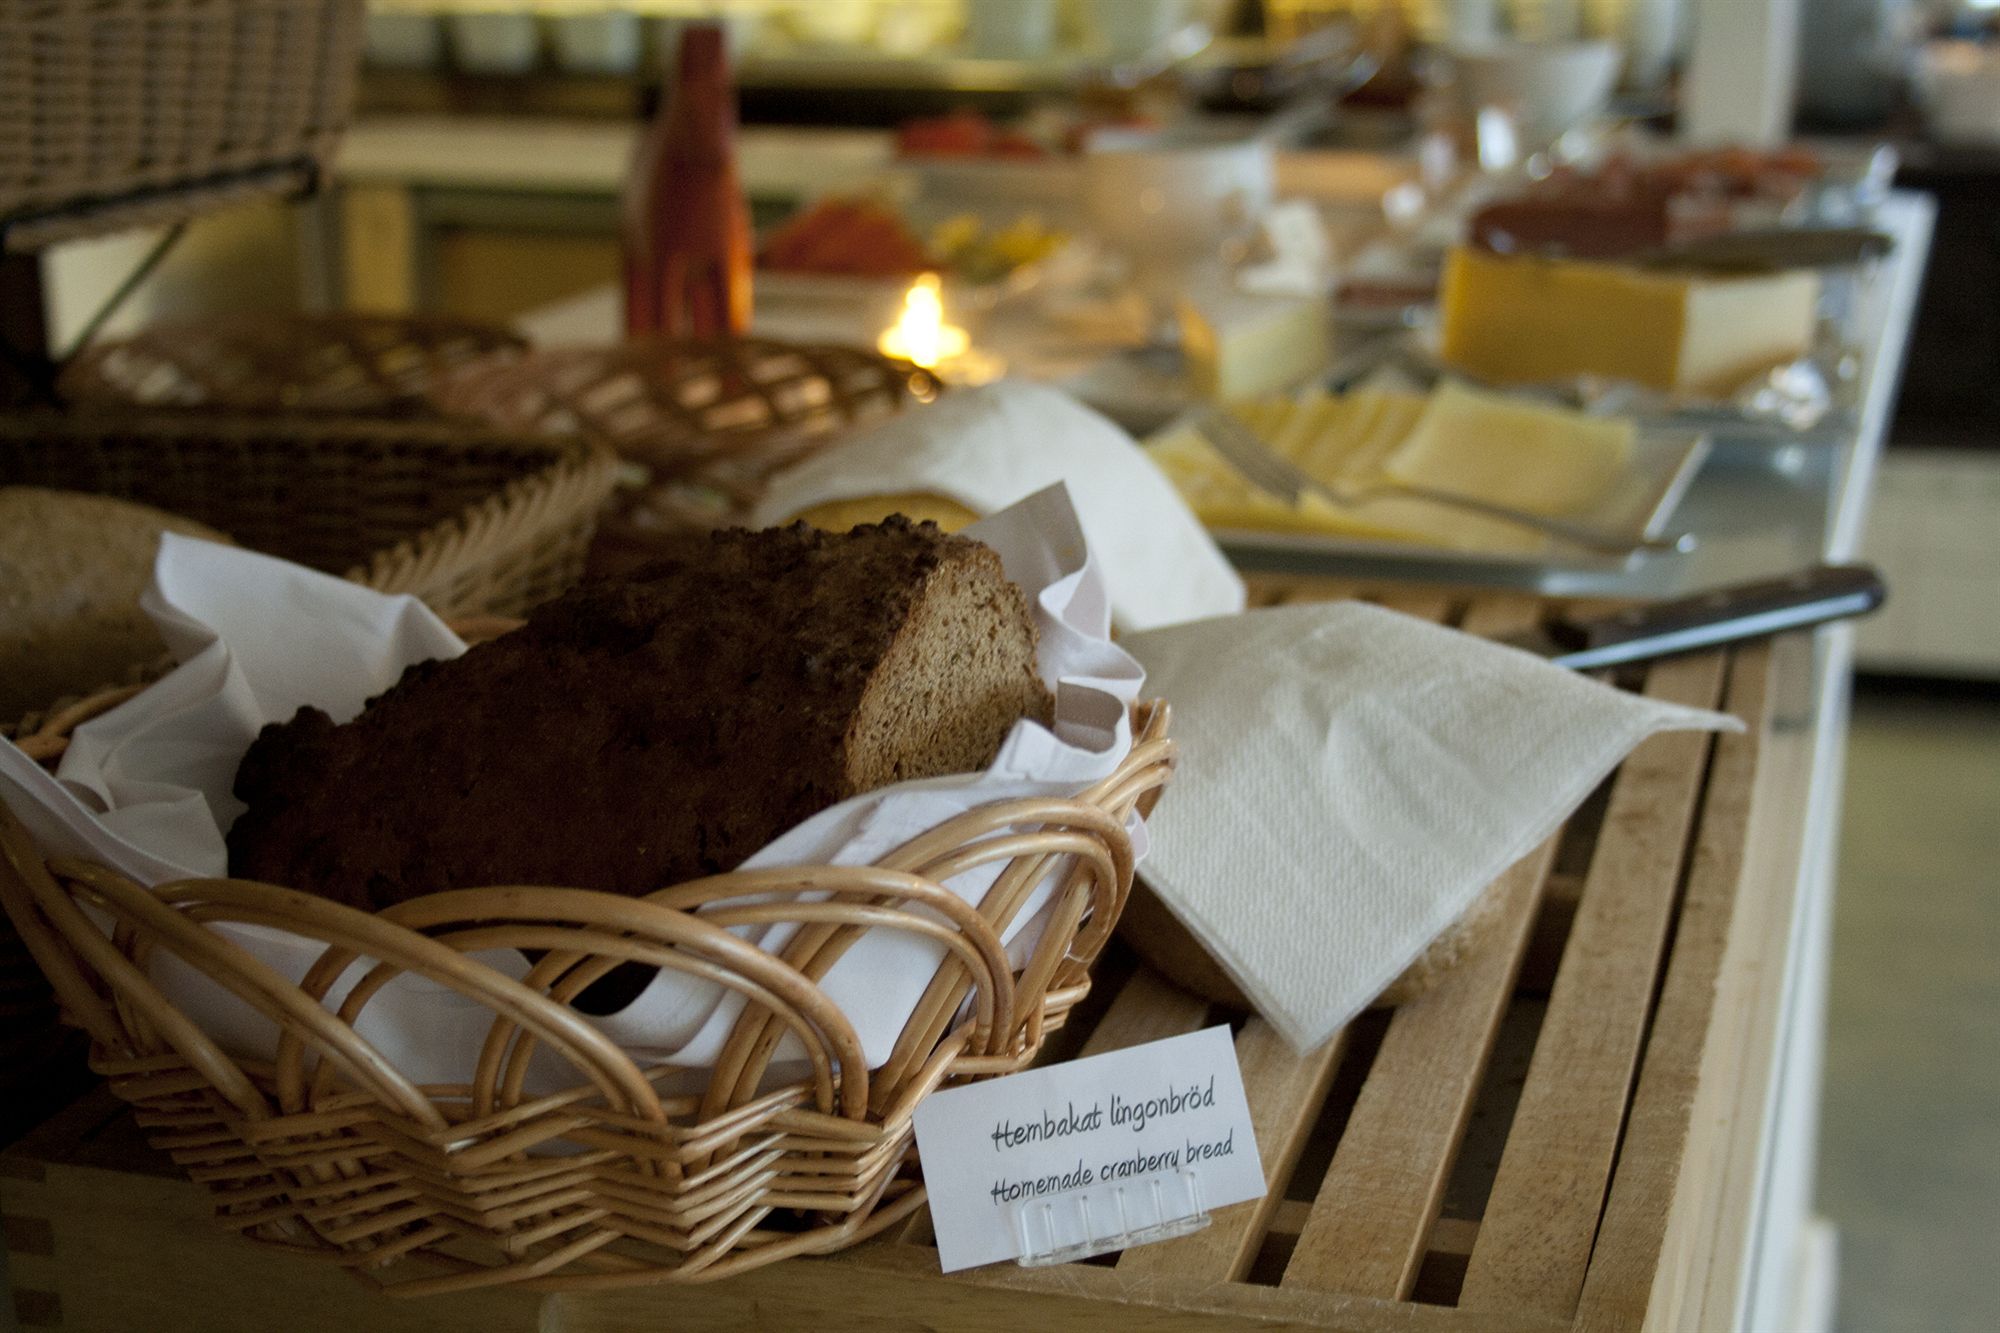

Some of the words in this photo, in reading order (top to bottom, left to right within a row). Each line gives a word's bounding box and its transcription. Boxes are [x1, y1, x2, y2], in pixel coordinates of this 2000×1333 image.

[991, 1102, 1103, 1151] Hembakat
[1110, 1073, 1216, 1133] lingonbröd
[990, 1159, 1094, 1206] Homemade
[1100, 1149, 1181, 1181] cranberry
[1185, 1127, 1235, 1164] bread
